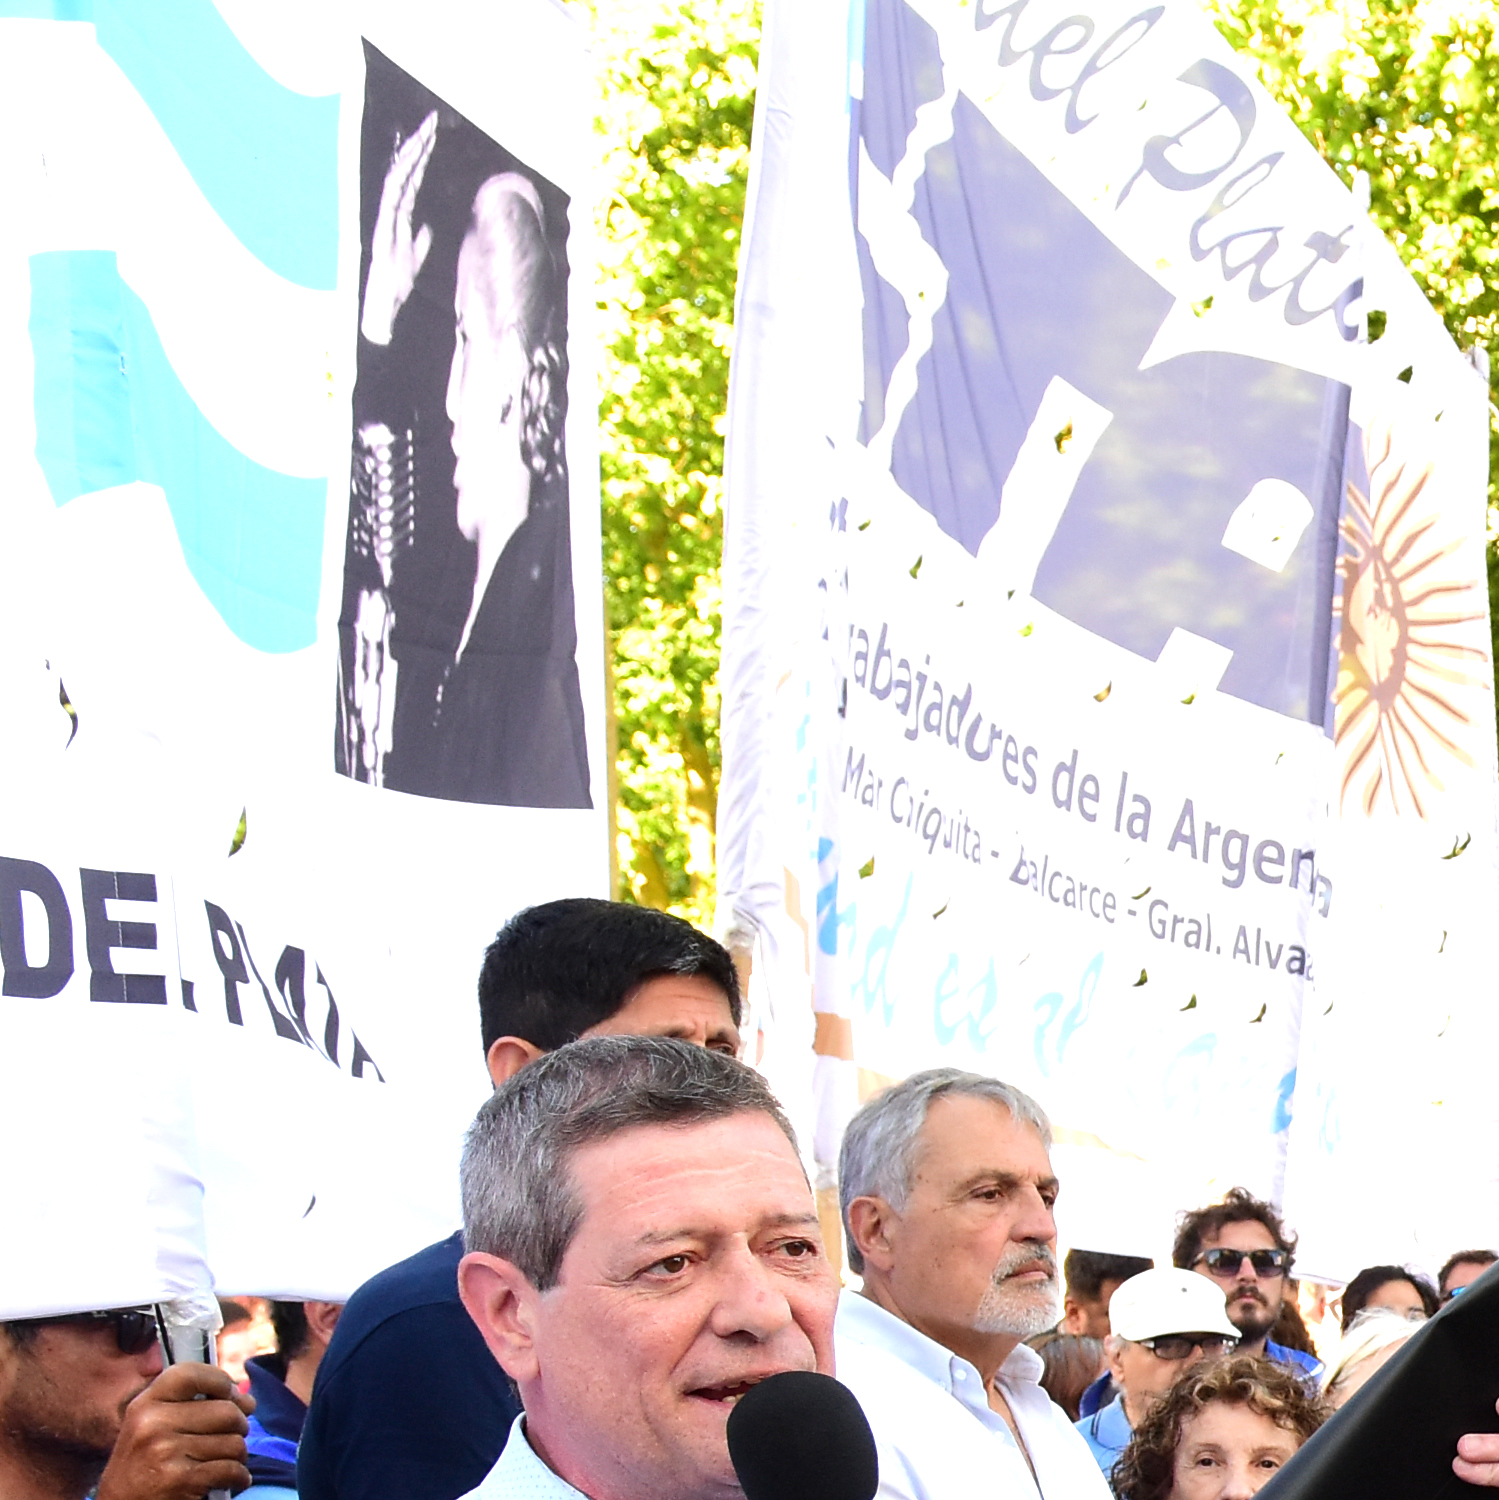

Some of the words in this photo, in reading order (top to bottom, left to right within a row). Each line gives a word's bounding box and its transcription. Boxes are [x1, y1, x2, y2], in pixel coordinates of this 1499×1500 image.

[1050, 747, 1101, 823] de
[1113, 770, 1152, 844] la
[0, 856, 199, 1014] DE
[1148, 899, 1221, 955] Gral.
